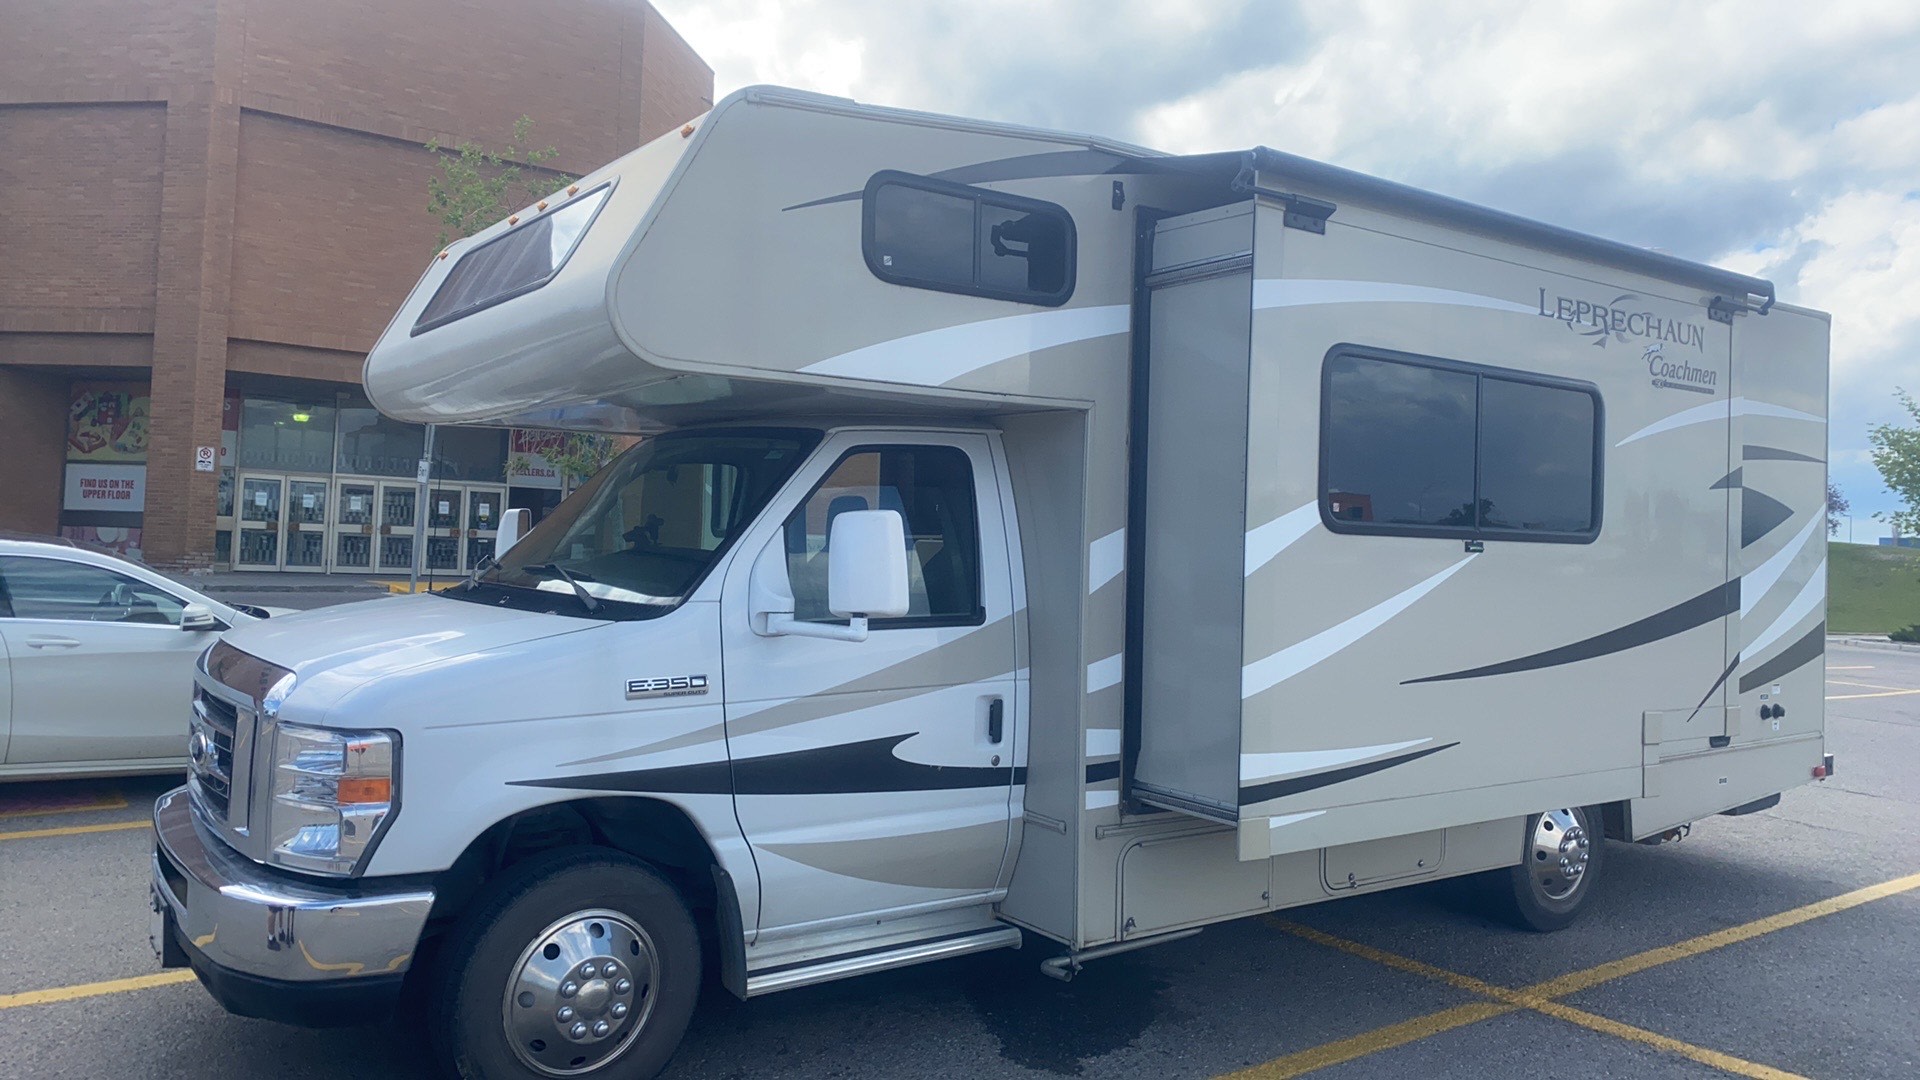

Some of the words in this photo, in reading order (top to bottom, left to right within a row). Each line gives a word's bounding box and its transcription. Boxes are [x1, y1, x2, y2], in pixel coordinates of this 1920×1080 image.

[1539, 287, 1704, 353] LEPRECHAUN
[1650, 355, 1716, 385] Coachmen
[80, 478, 97, 488] FIND
[98, 479, 107, 488] US
[109, 479, 119, 488] ON
[121, 480, 134, 489] THE
[83, 489, 106, 499] UPPER
[108, 490, 131, 500] FLOOR
